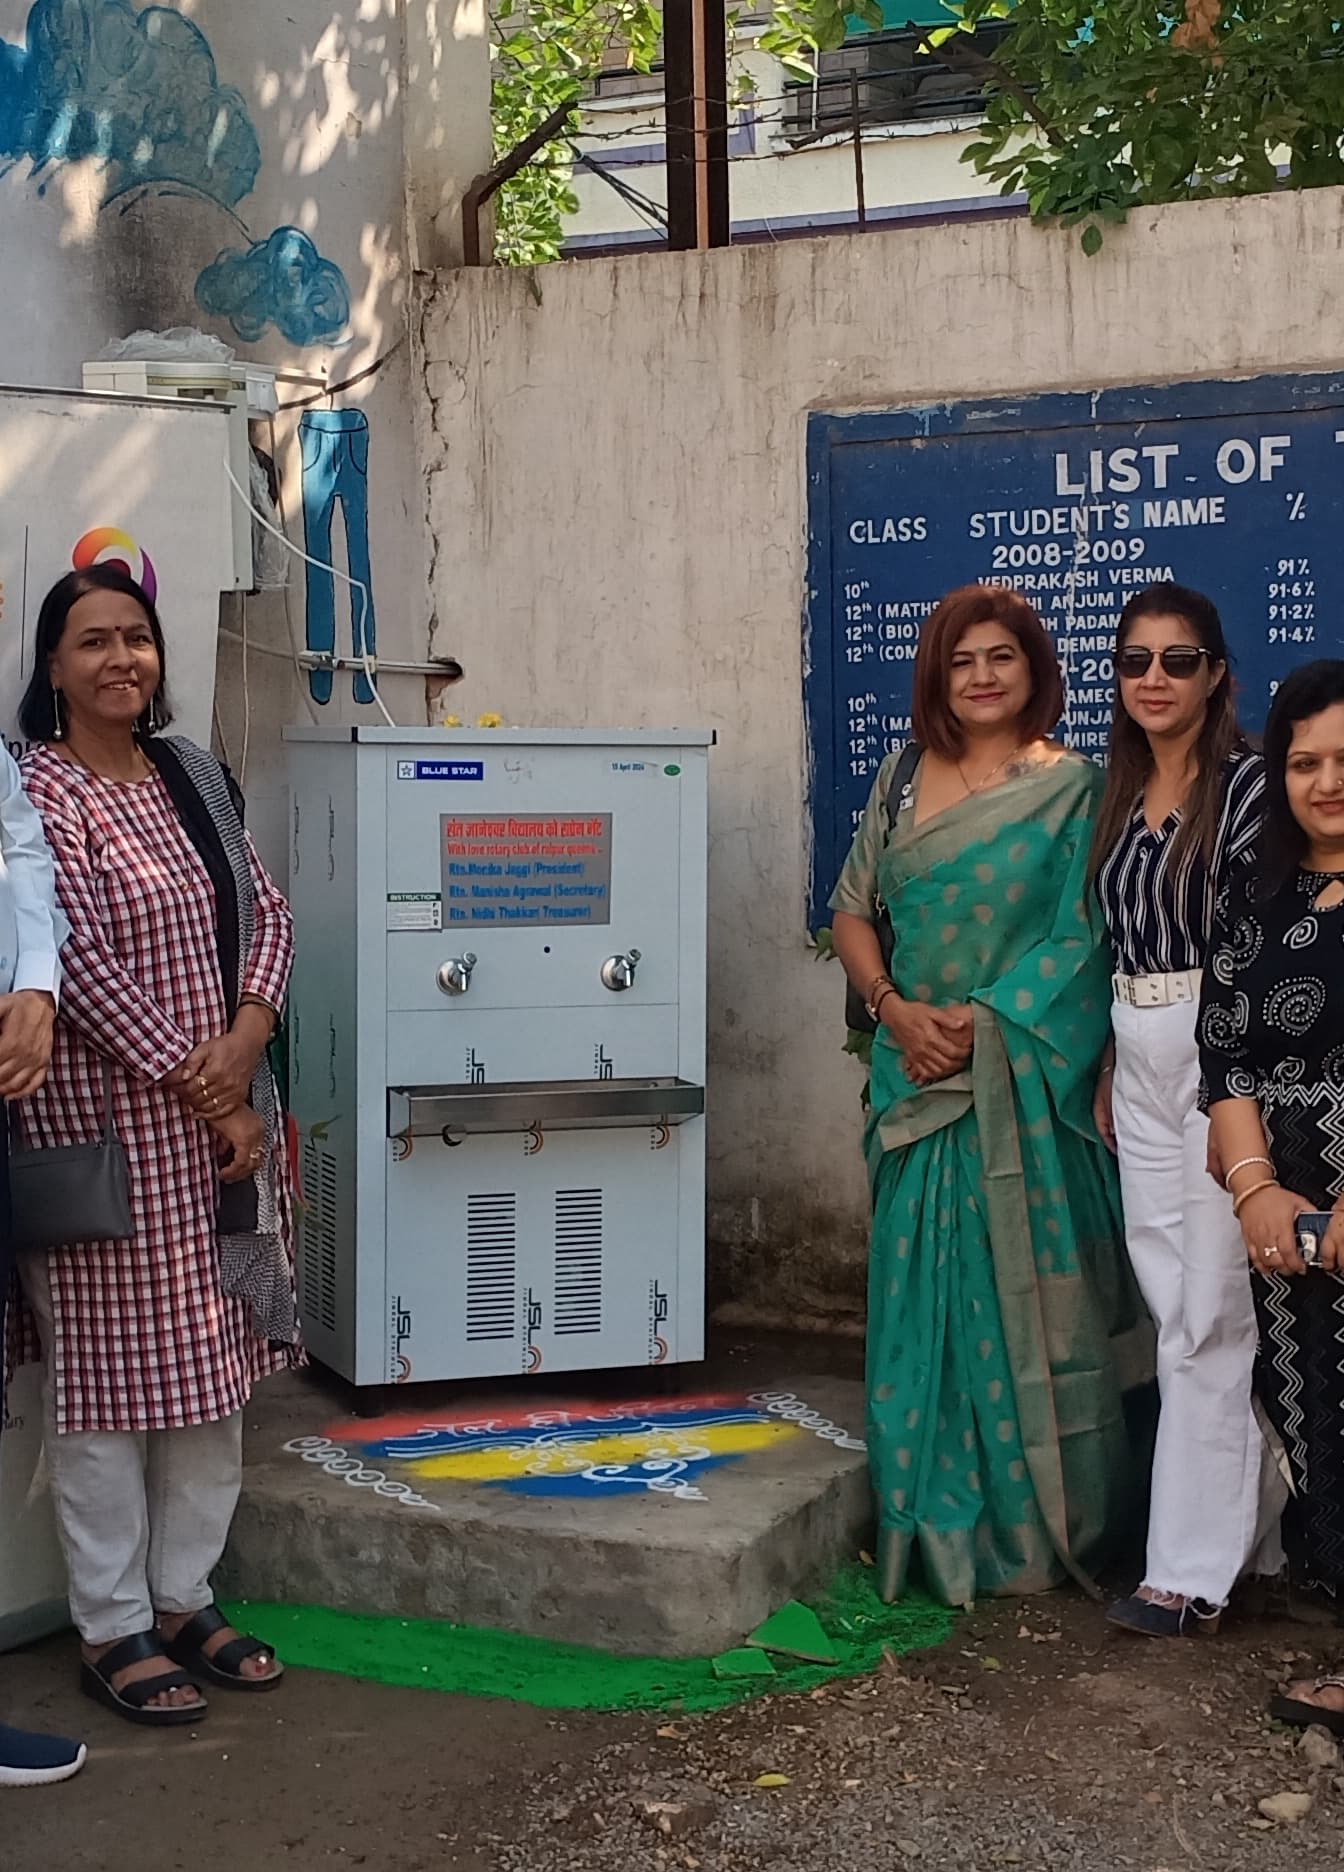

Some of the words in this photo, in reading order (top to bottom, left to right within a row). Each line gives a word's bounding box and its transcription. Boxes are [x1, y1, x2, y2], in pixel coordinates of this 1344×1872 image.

[1055, 444, 1179, 495] LIST
[1216, 435, 1291, 484] OF
[849, 517, 927, 543] CLASS
[969, 501, 1130, 538] STUDENT'S
[1143, 497, 1225, 528] NAME
[1286, 492, 1306, 520] %
[992, 538, 1145, 568] 2008-2009
[843, 580, 869, 599] 10th
[1109, 567, 1175, 584] VERMA
[845, 602, 872, 620] 12th
[1051, 591, 1114, 611] ANJUM
[845, 623, 873, 641] 12th
[878, 622, 920, 641] (BIO)
[846, 643, 874, 662] 12th
[879, 643, 918, 662] (COM
[847, 693, 877, 712] 10th
[848, 715, 878, 732] 12th
[882, 715, 912, 732] (MA
[848, 736, 877, 754] 12th
[421, 766, 449, 775] BLUE
[451, 766, 478, 775] STAR
[850, 757, 879, 776] 12th
